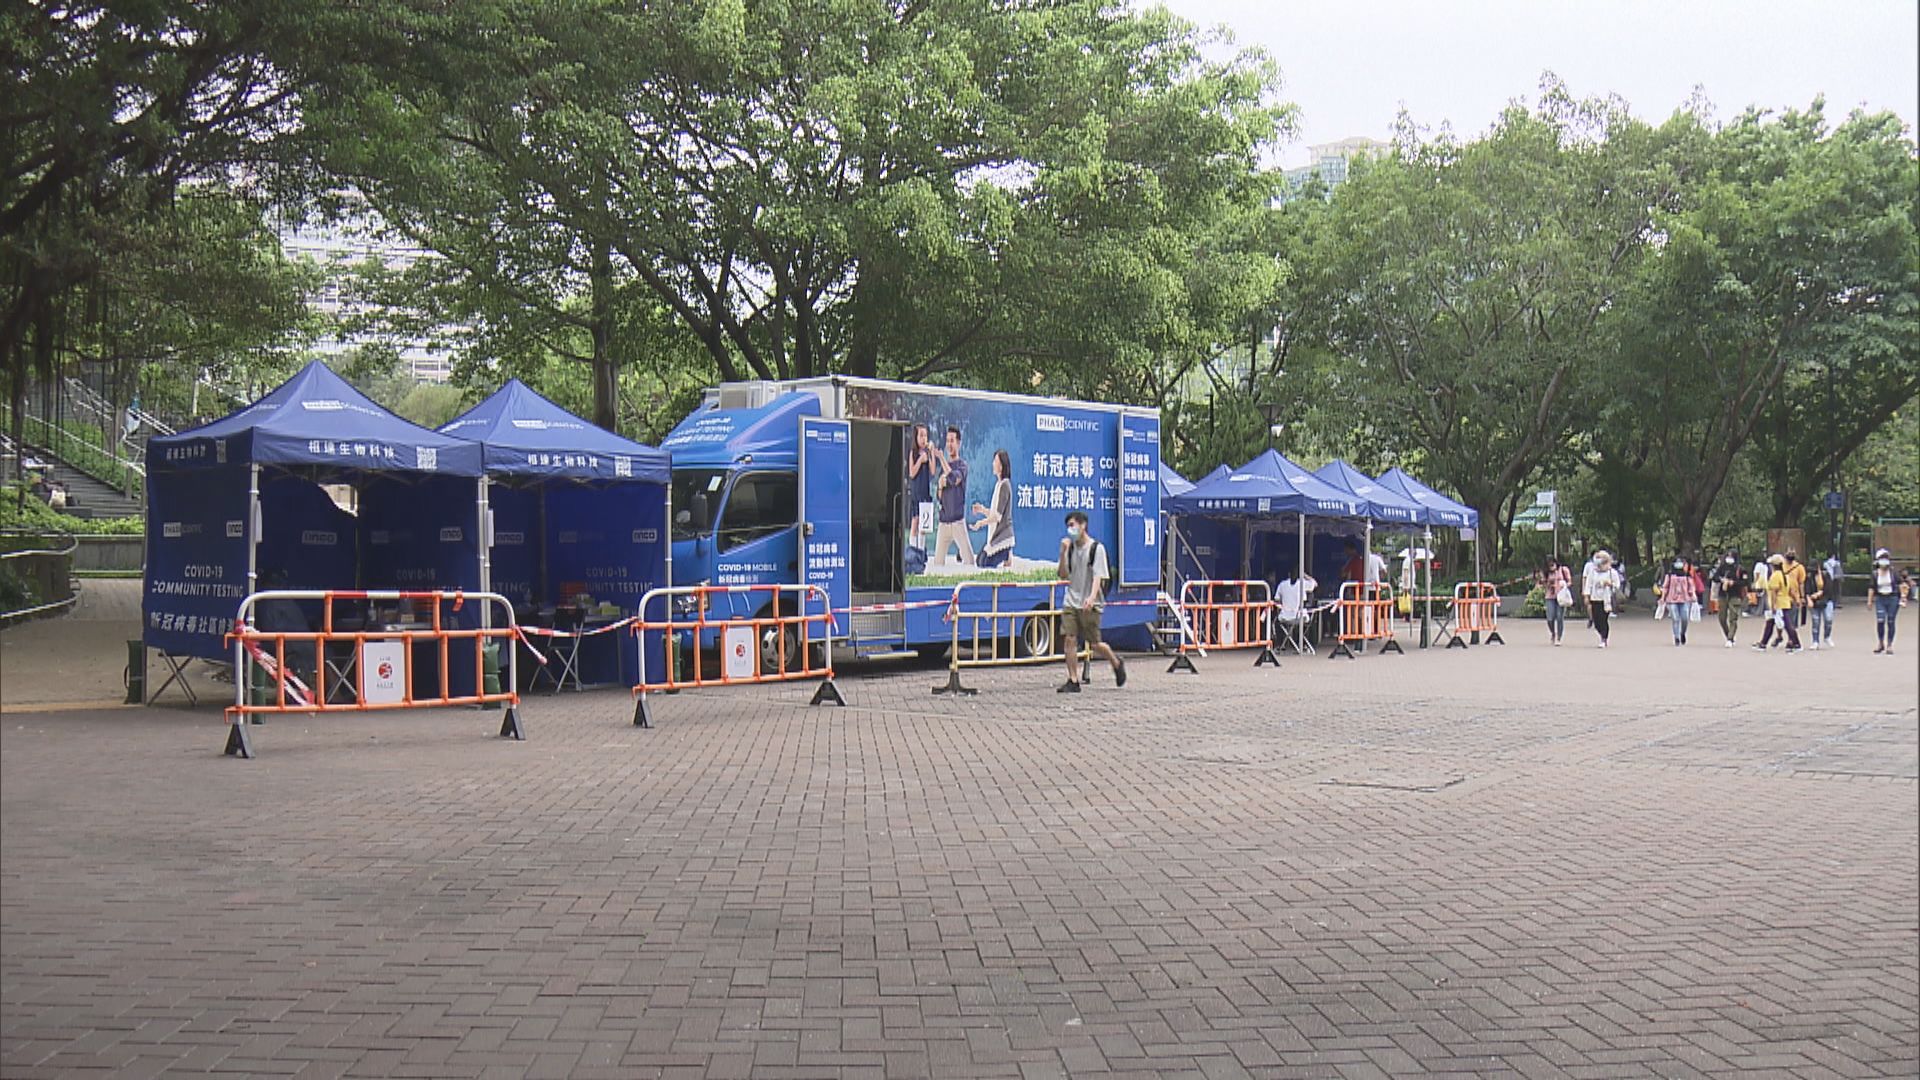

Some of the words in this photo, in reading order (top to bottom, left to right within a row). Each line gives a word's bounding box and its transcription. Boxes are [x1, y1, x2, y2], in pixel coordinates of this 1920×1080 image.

[1033, 452, 1094, 479] 新冠病毒
[1099, 457, 1119, 470] COV
[1100, 477, 1119, 490] MOB
[1017, 484, 1095, 510] 流動檢測站
[922, 511, 930, 529] 2
[184, 565, 223, 579] COVID-19
[718, 563, 751, 572] COVID-19
[752, 563, 777, 572] MOBILE
[212, 584, 244, 599] TESTING
